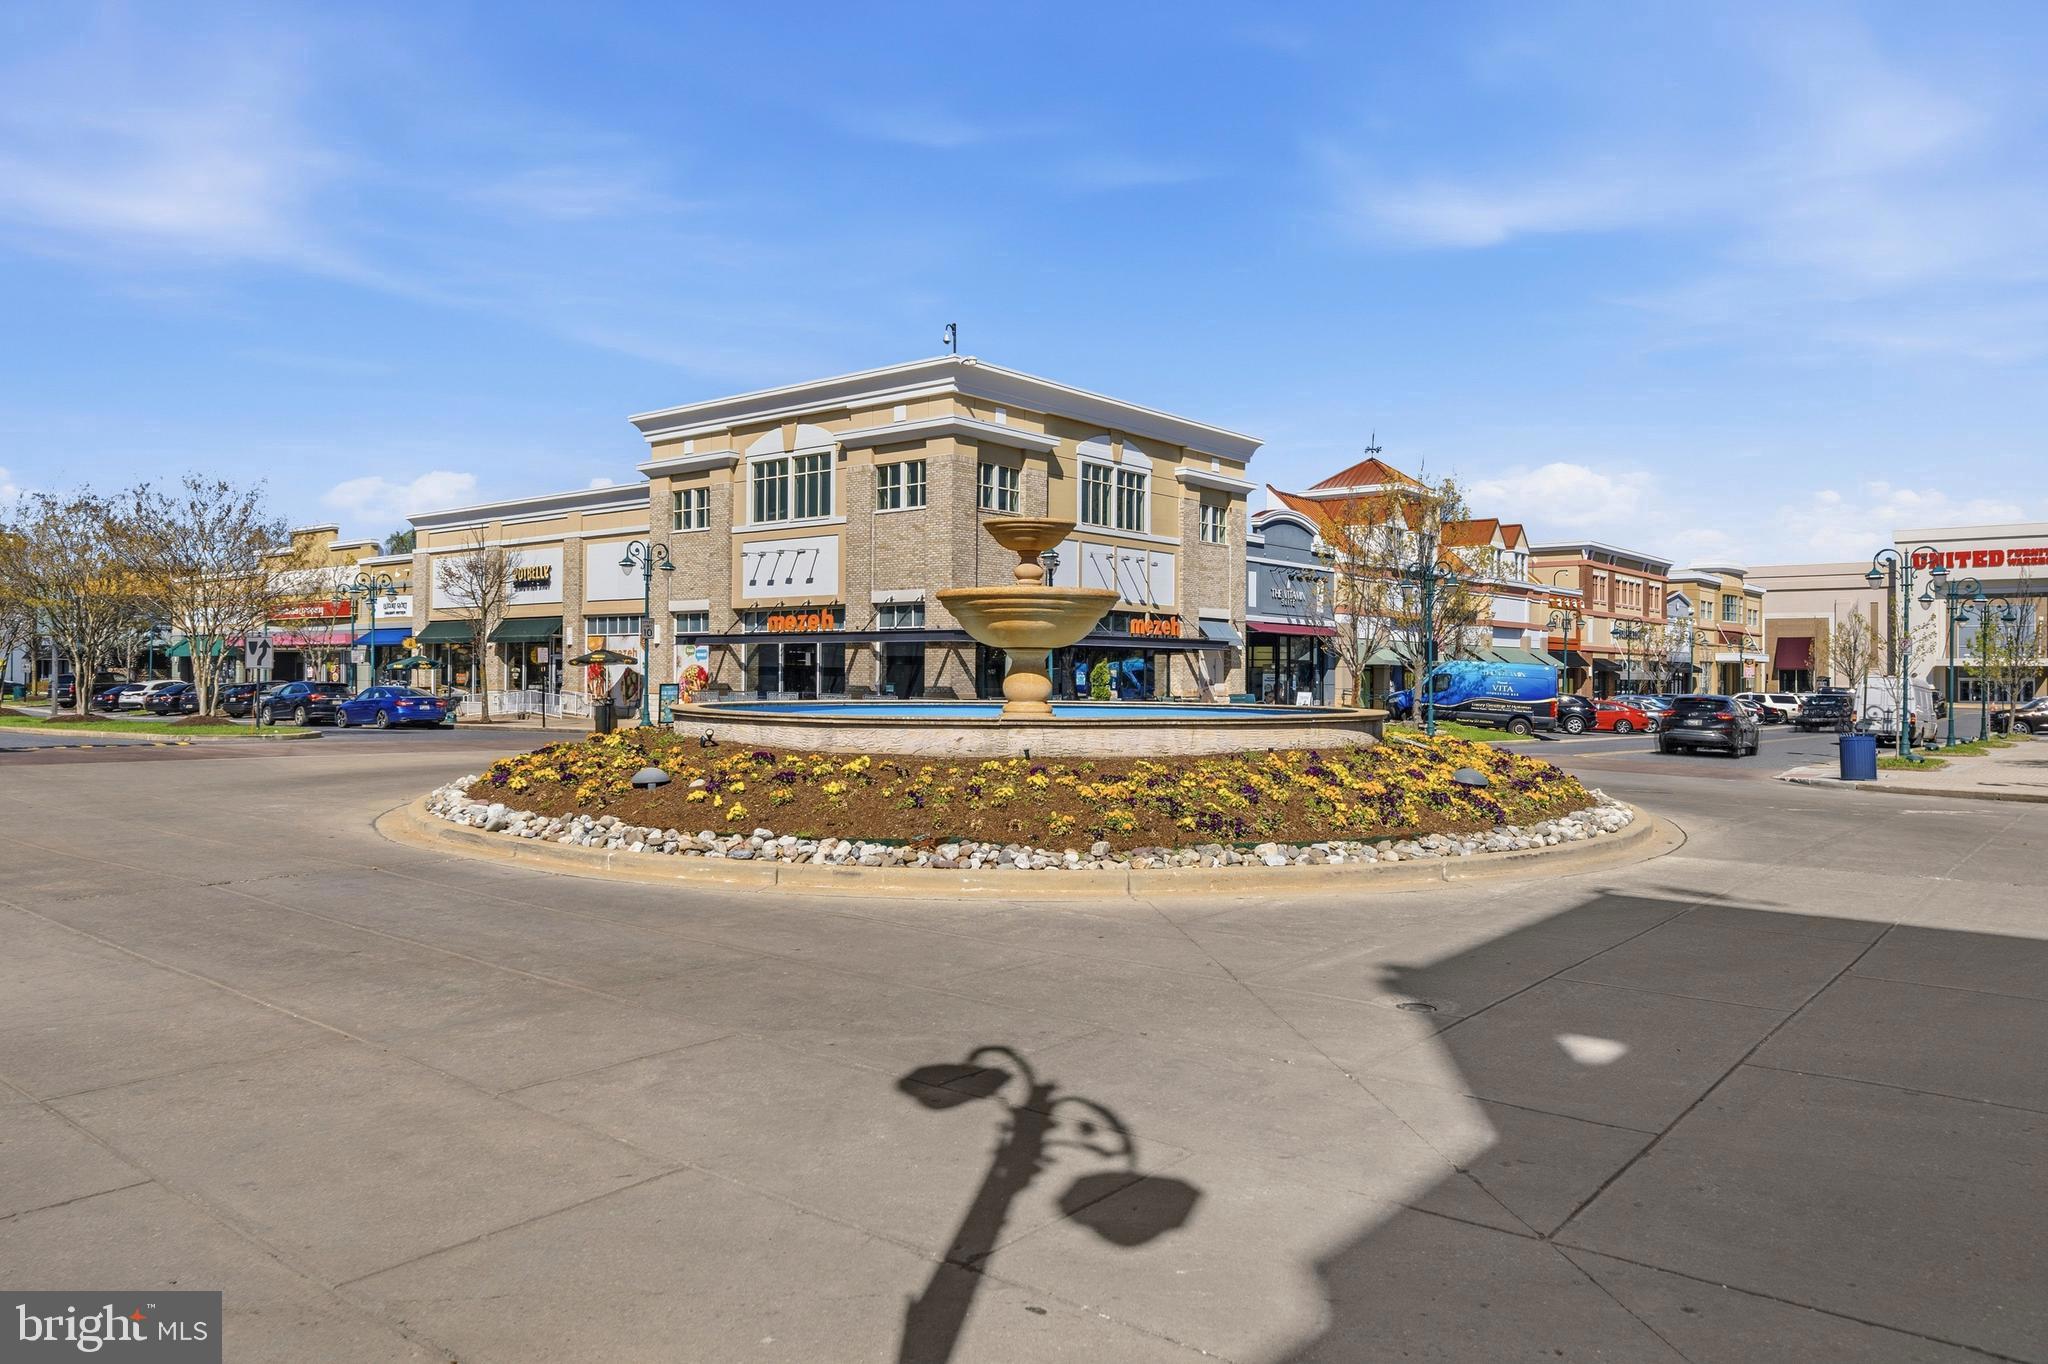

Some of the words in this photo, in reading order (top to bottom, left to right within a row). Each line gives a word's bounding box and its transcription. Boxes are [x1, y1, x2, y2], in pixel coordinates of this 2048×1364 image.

[1912, 549, 2005, 570] UNITED
[1271, 588, 1282, 599] THE
[768, 608, 834, 633] mezeh
[1130, 616, 1180, 636] mezeh
[643, 628, 653, 637] 10
[1492, 684, 1514, 693] VITA
